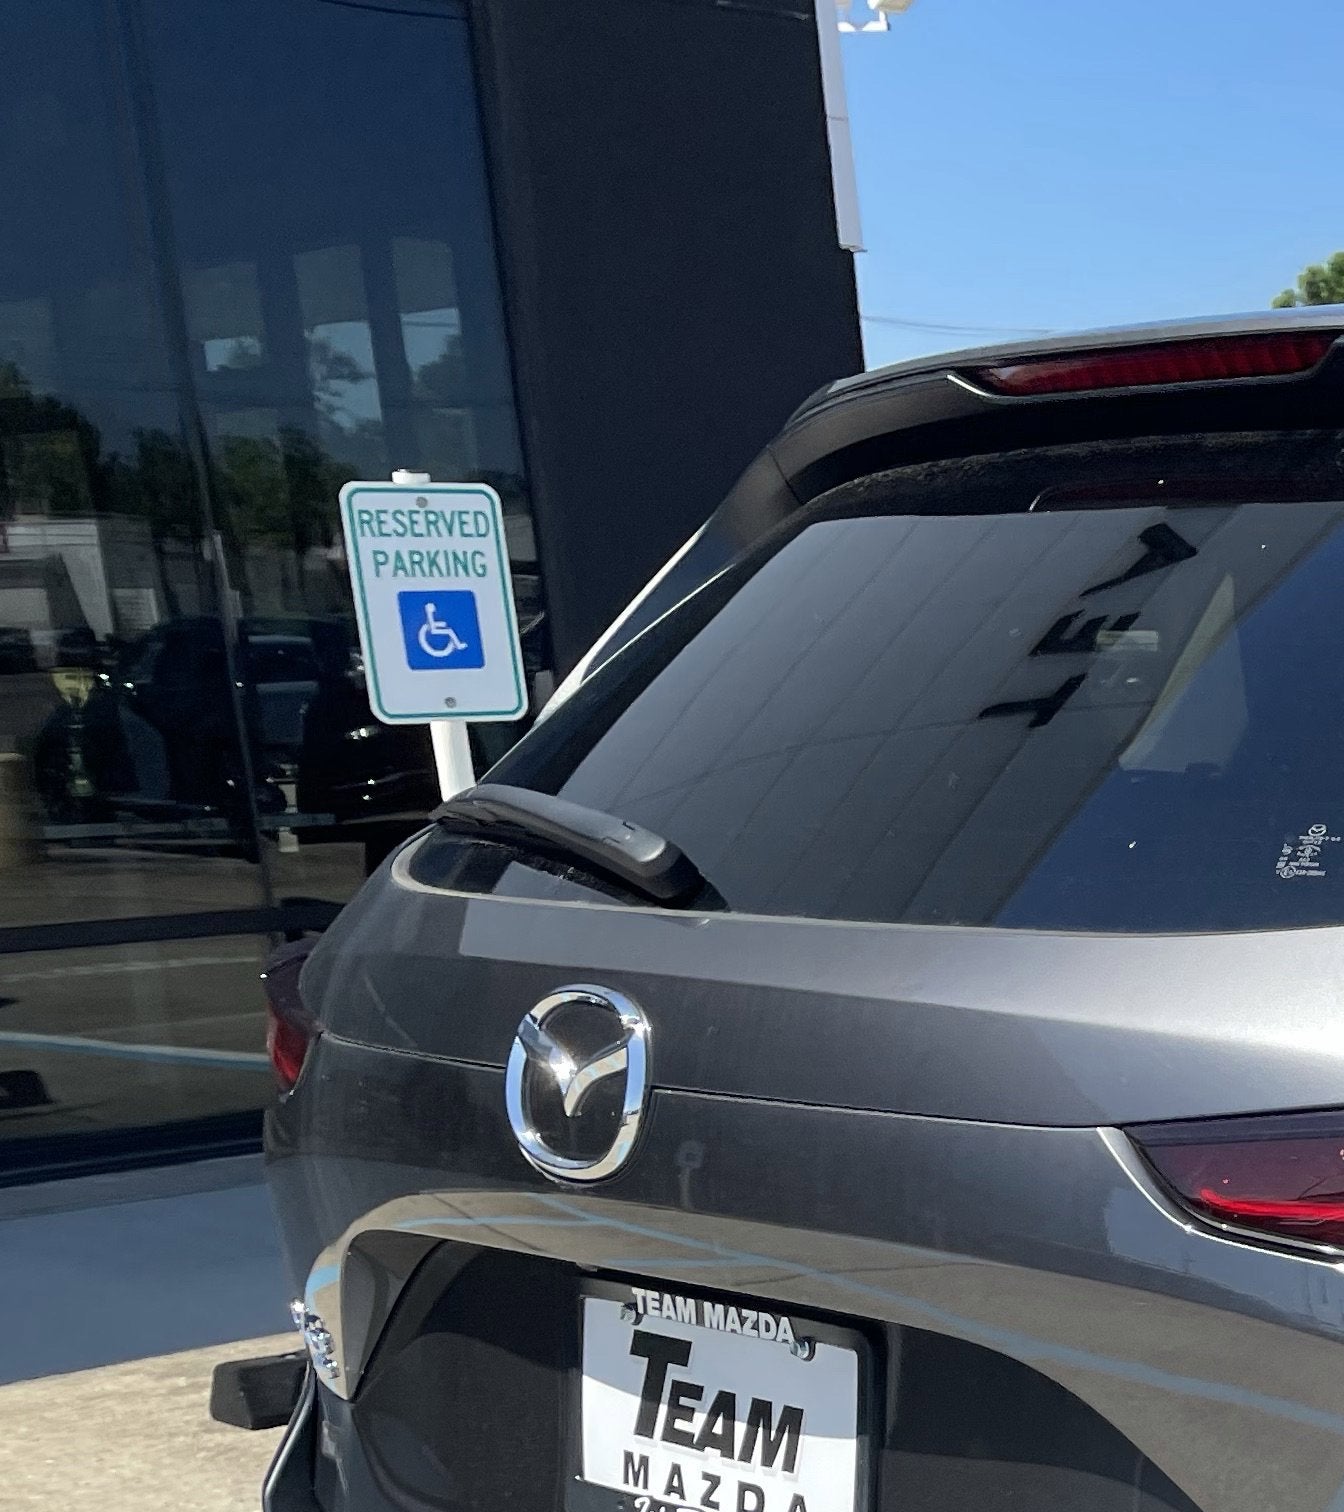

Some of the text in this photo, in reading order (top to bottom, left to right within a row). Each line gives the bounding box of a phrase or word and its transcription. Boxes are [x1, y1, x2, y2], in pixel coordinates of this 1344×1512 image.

[357, 509, 490, 538] RESERVED
[372, 549, 488, 578] PARKING
[631, 1286, 796, 1344] TEAM MAZDA
[629, 1329, 805, 1474] TEAM
